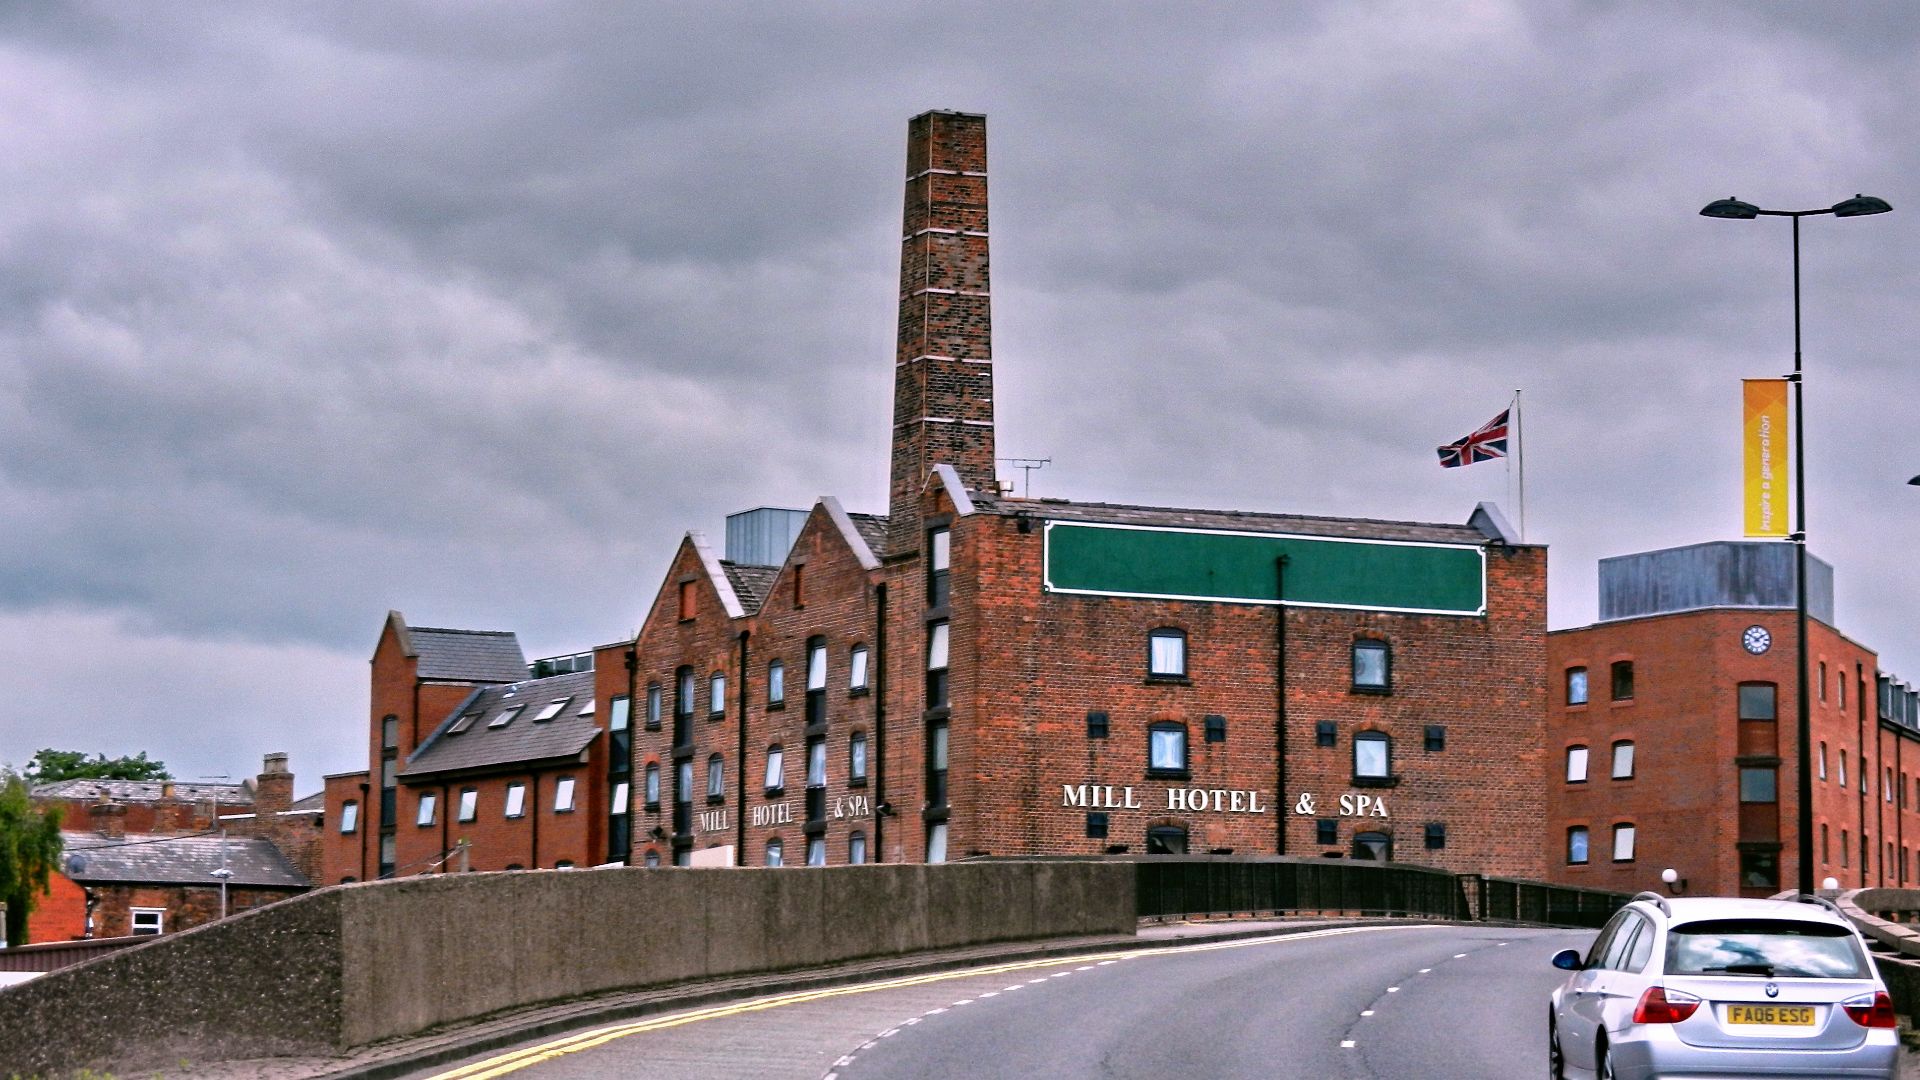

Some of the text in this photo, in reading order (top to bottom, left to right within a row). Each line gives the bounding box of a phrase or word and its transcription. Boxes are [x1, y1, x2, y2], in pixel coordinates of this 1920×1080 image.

[1759, 415, 1773, 480] generation
[700, 795, 869, 832] MILL HOTEL & SPA
[1062, 784, 1388, 817] MILL HOTEL & SPA
[1733, 1007, 1810, 1023] FA06 ESG
